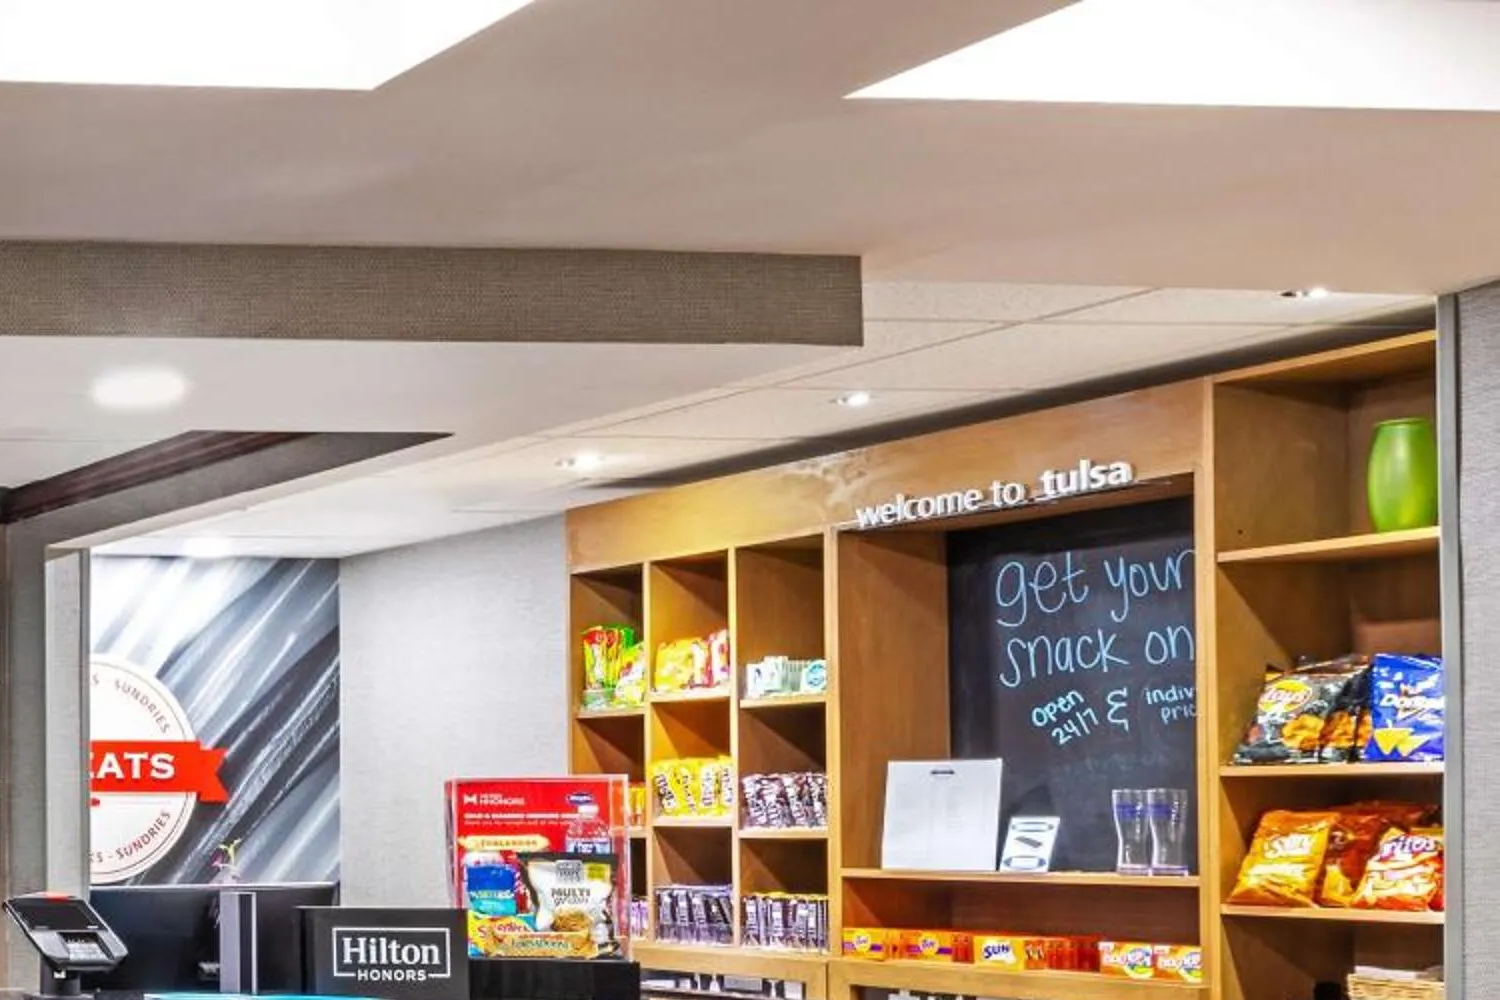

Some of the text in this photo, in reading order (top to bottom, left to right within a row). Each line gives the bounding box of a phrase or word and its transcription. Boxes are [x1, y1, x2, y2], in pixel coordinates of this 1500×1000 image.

[855, 459, 1134, 529] welcome to tulsa
[996, 550, 1196, 627] get your
[1000, 628, 1130, 687] snack
[114, 678, 171, 735] SUNDRIES
[1051, 708, 1099, 745] 24/7
[115, 811, 172, 860] SUNDRIES
[342, 936, 442, 965] Hilton
[357, 968, 427, 981] HONORS
